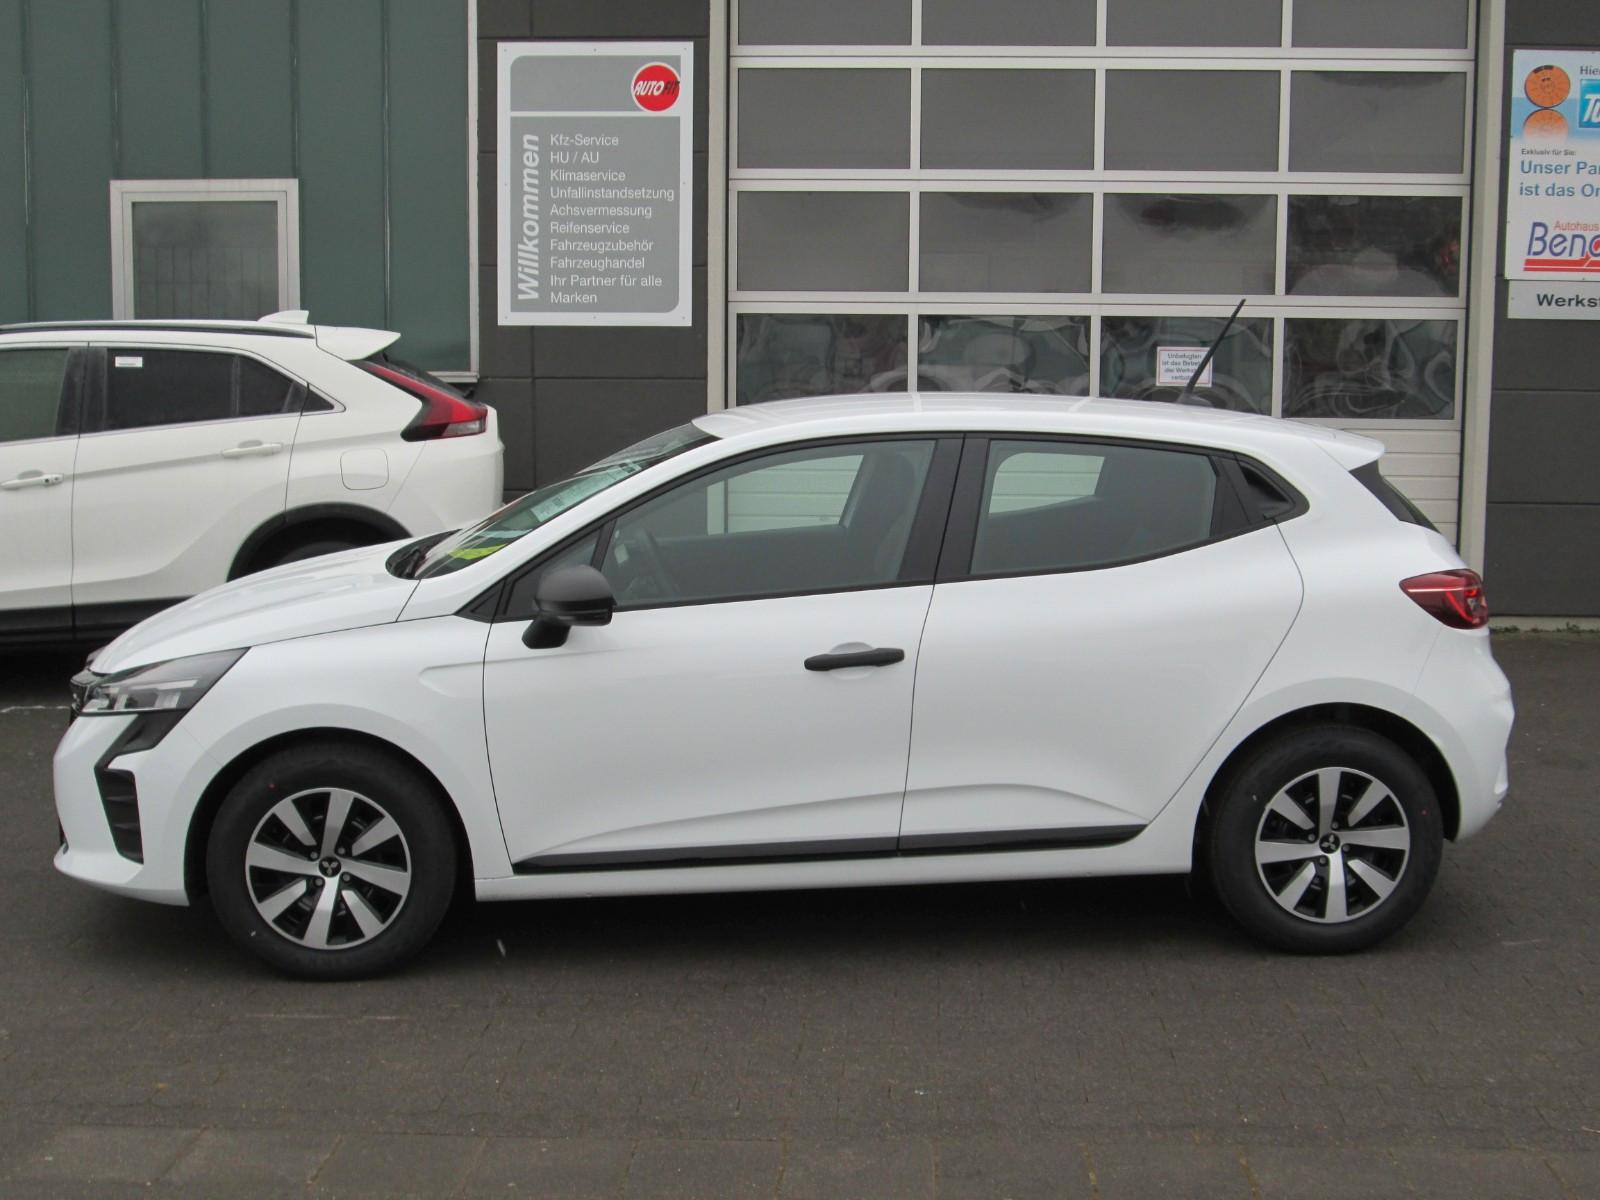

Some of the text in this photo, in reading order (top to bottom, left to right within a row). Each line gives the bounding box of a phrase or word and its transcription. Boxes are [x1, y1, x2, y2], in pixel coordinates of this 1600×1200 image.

[1579, 66, 1600, 76] Hie
[550, 134, 619, 146] Kfz-Service
[550, 151, 600, 164] HU / AU
[1520, 160, 1572, 174] Unser
[550, 169, 626, 182] Klimaservice
[550, 186, 675, 202] Unfallinstandsetzung
[1519, 182, 1540, 196] ist
[1545, 183, 1575, 197] das
[518, 134, 540, 301] Willkommen
[550, 204, 653, 219] Achsvermessung
[550, 221, 630, 234] Reifenservice
[1553, 221, 1599, 232] Autohaus
[550, 238, 655, 254] Fahrzeugzubehör
[550, 256, 646, 271] Fahrzeughandel
[550, 274, 663, 288] Ihr Partner für alle
[550, 292, 598, 304] Marken
[1536, 293, 1600, 307] Werks
